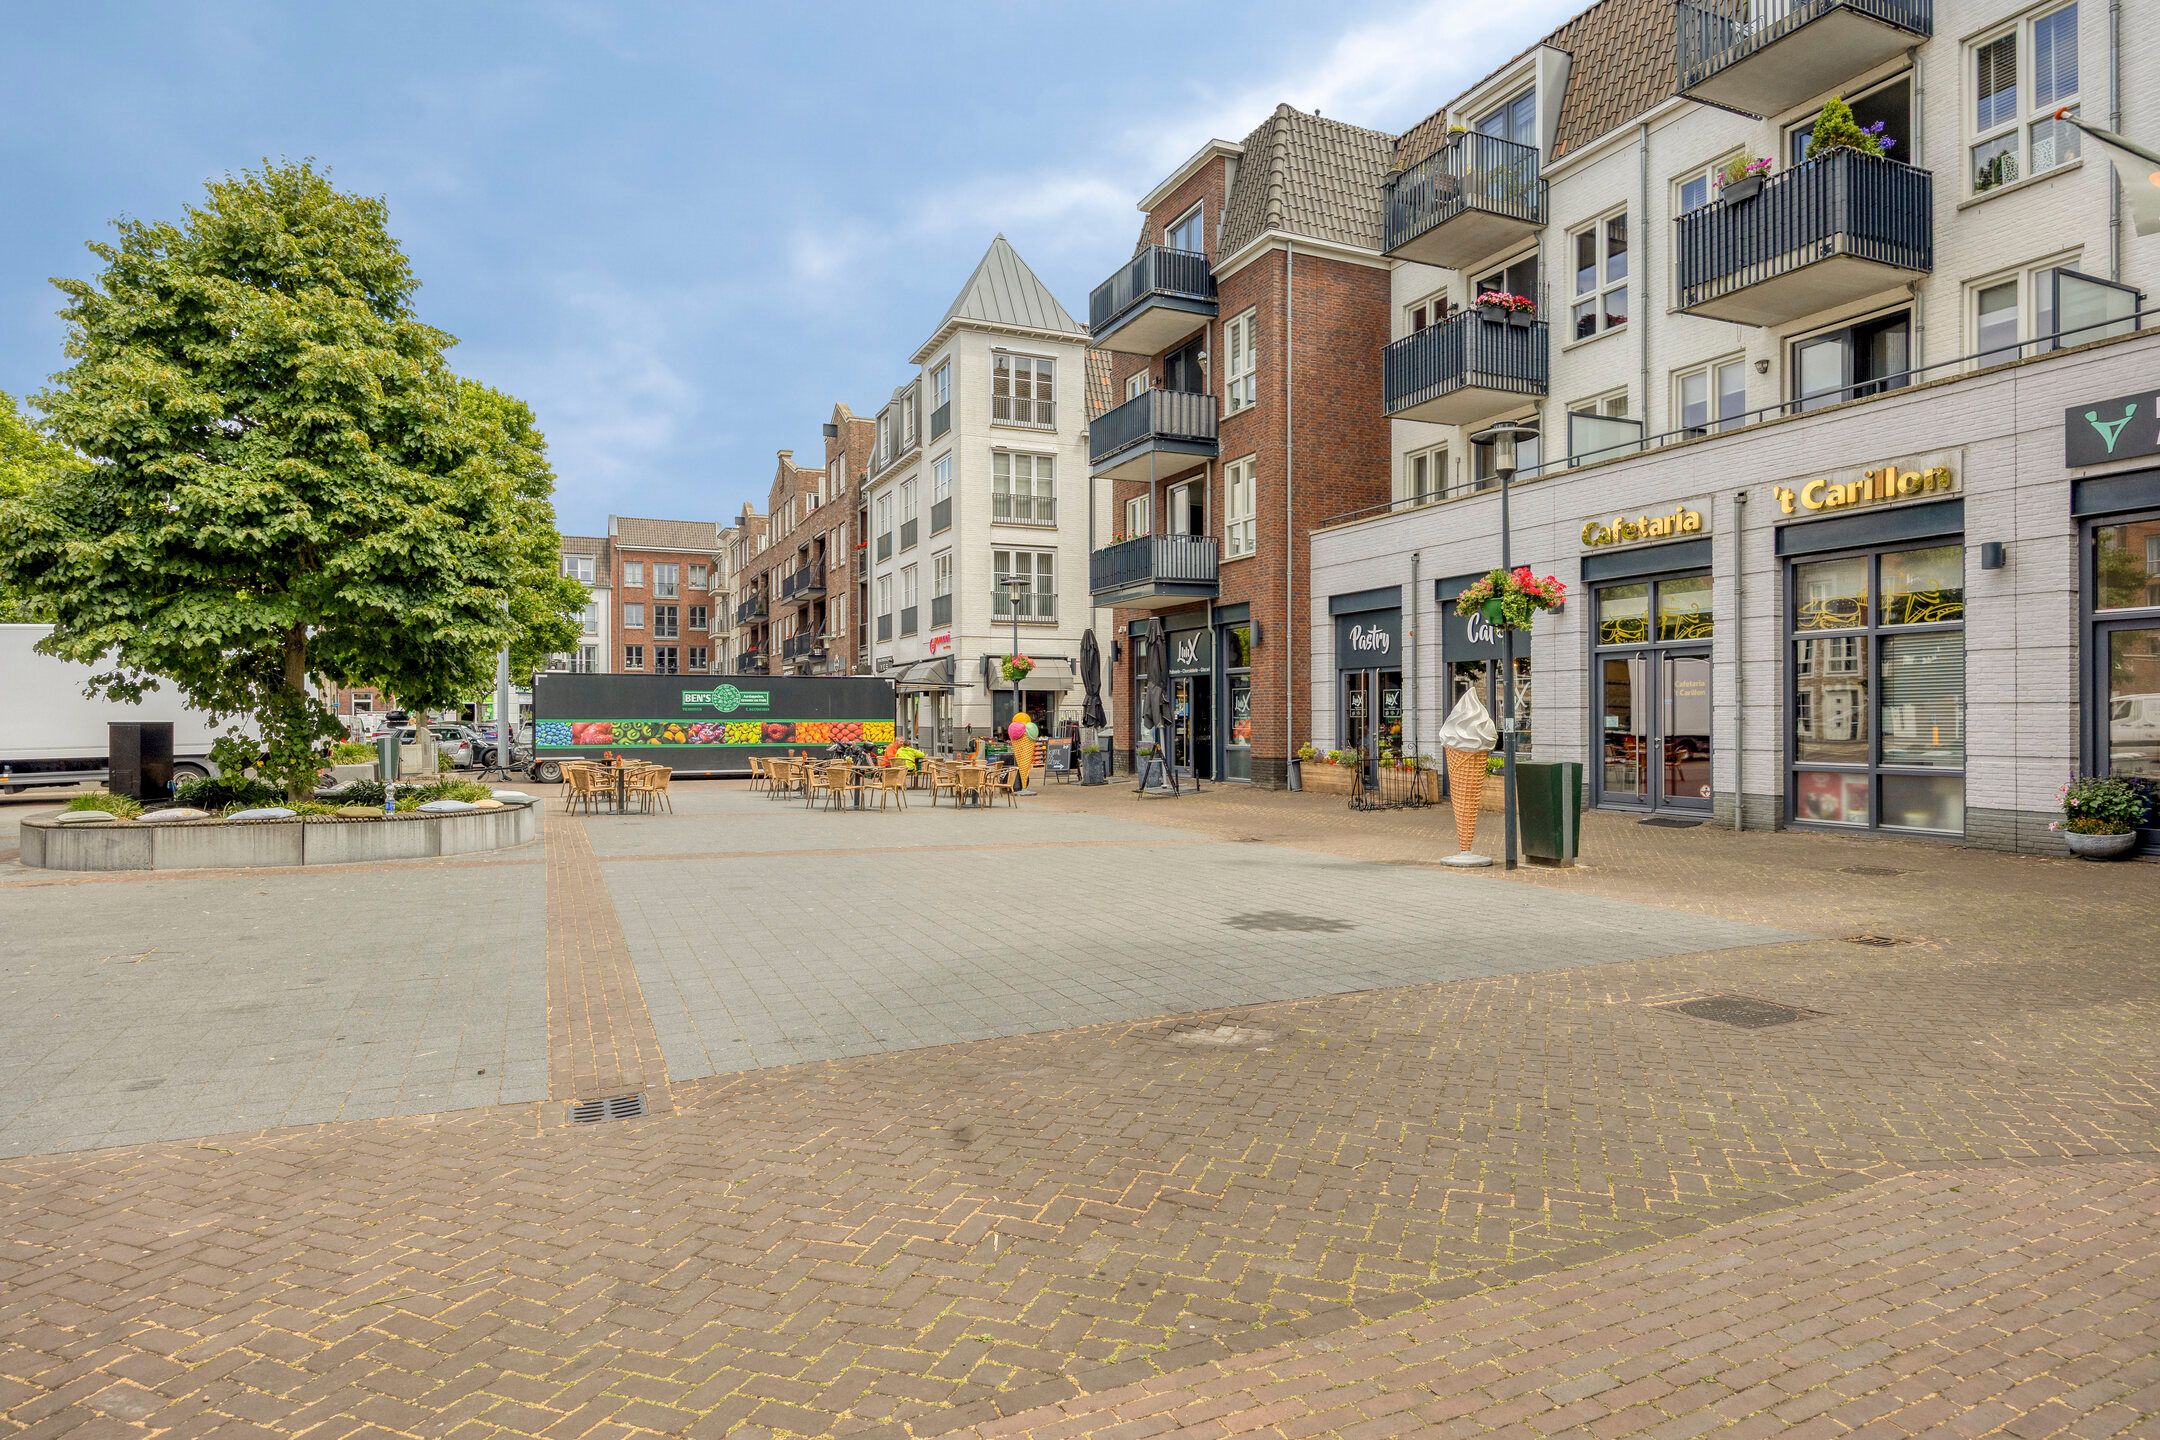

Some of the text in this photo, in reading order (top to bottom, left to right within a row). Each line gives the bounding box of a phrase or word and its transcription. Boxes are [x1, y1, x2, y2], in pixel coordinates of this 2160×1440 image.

[1773, 465, 1952, 514] 't Carillon
[1581, 505, 1702, 547] Cafetaria
[1349, 624, 1390, 655] Pastry
[1674, 680, 1706, 688] Cafetaria
[1680, 689, 1706, 697] Carillon
[685, 693, 712, 703] BEN'S
